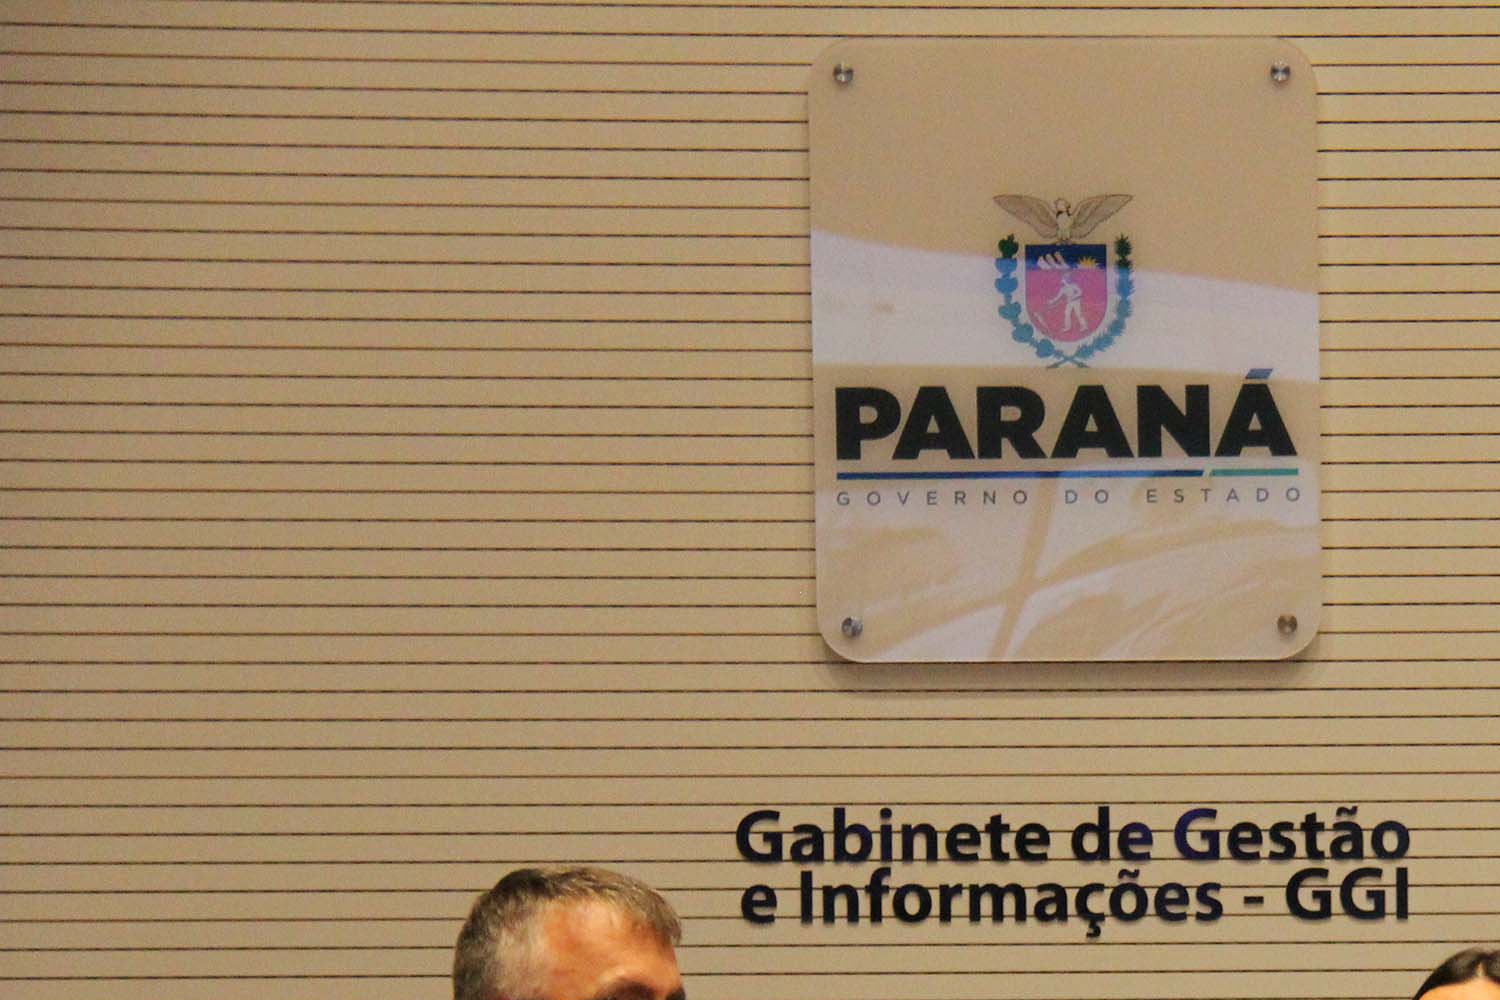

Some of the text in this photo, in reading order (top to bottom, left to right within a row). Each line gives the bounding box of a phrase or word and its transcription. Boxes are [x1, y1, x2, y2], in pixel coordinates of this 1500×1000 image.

[834, 367, 1299, 461] PARANÁ
[836, 486, 1302, 507] GOVERNO DO ESTADO
[735, 805, 1411, 864] Gabinete de Gestão
[740, 883, 778, 924] e
[799, 866, 1224, 938] Informações
[1285, 866, 1410, 922] GGI
